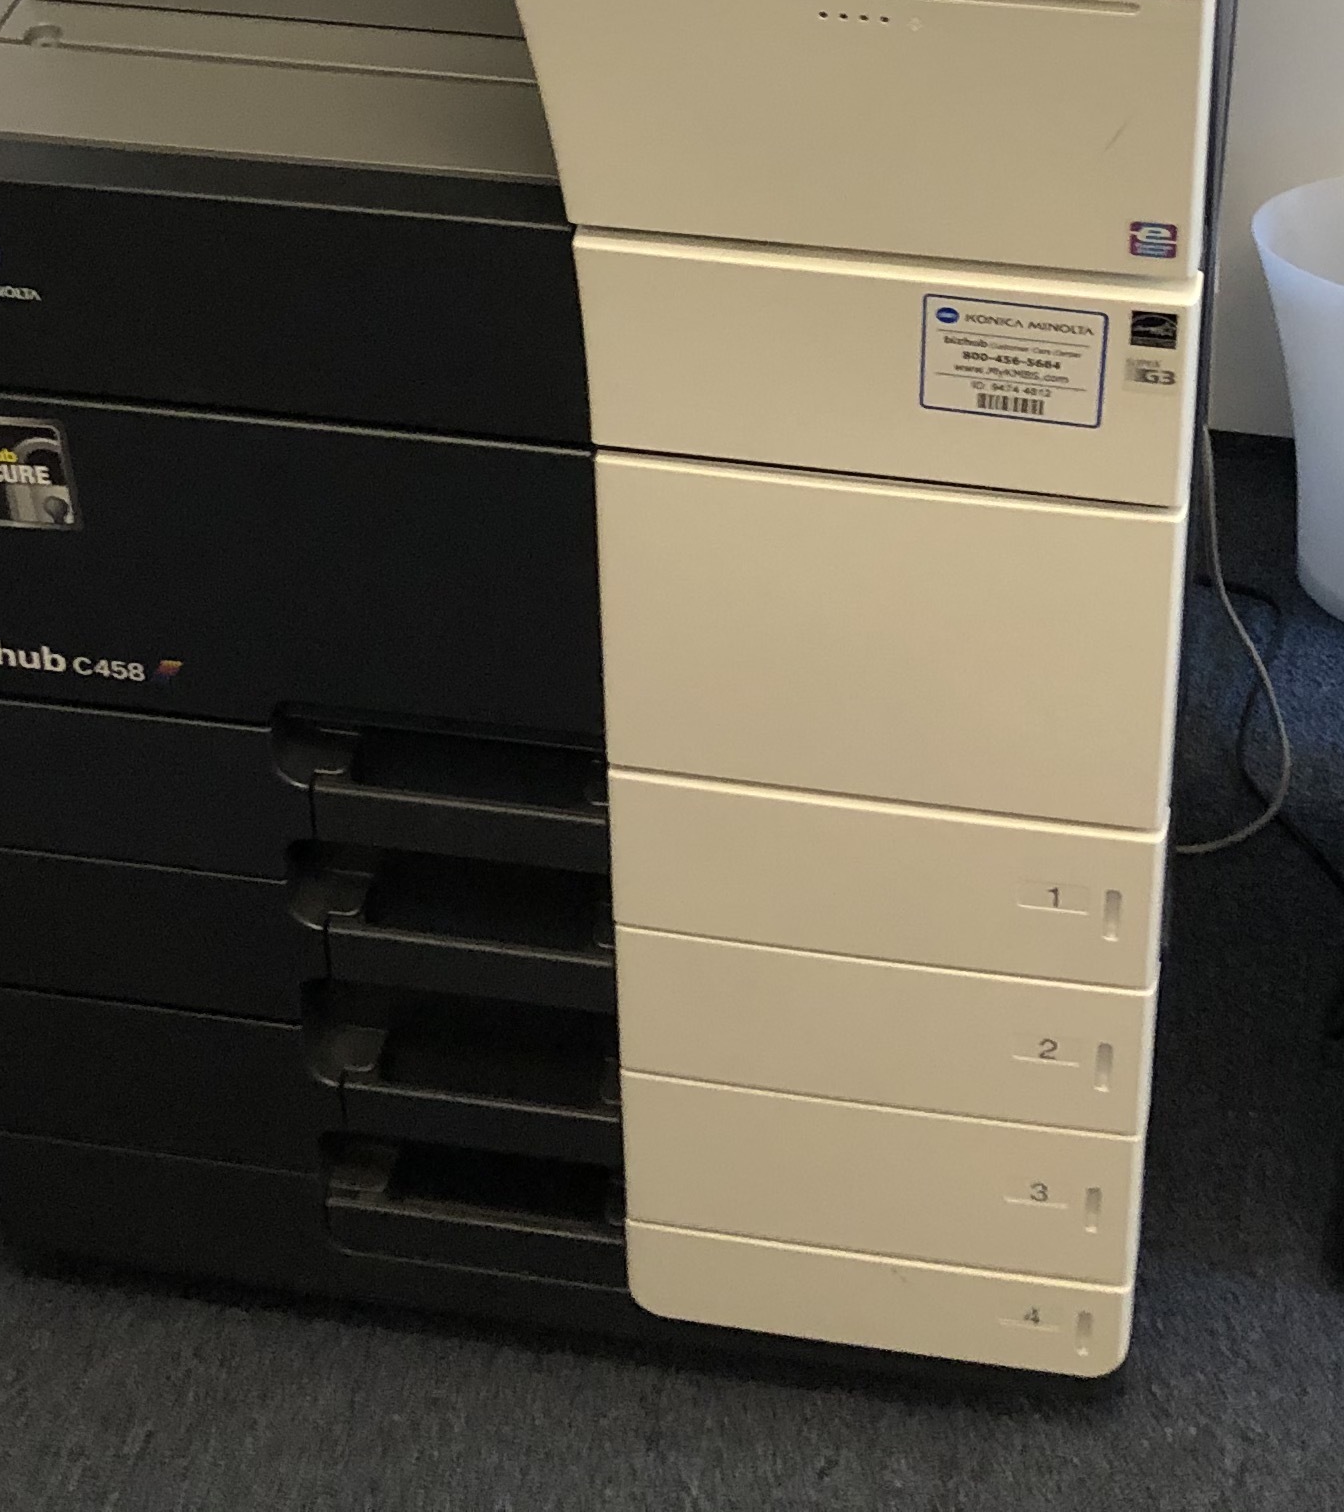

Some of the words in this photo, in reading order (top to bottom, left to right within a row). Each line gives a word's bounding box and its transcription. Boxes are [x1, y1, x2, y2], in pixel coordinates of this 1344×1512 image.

[964, 313, 1024, 329] KONICA
[1027, 321, 1095, 336] MINOLTA
[72, 656, 146, 682] C458
[1047, 887, 1060, 908] 1
[1038, 1038, 1059, 1060] 2
[1030, 1182, 1049, 1202] 3
[1023, 1307, 1040, 1324] 4
